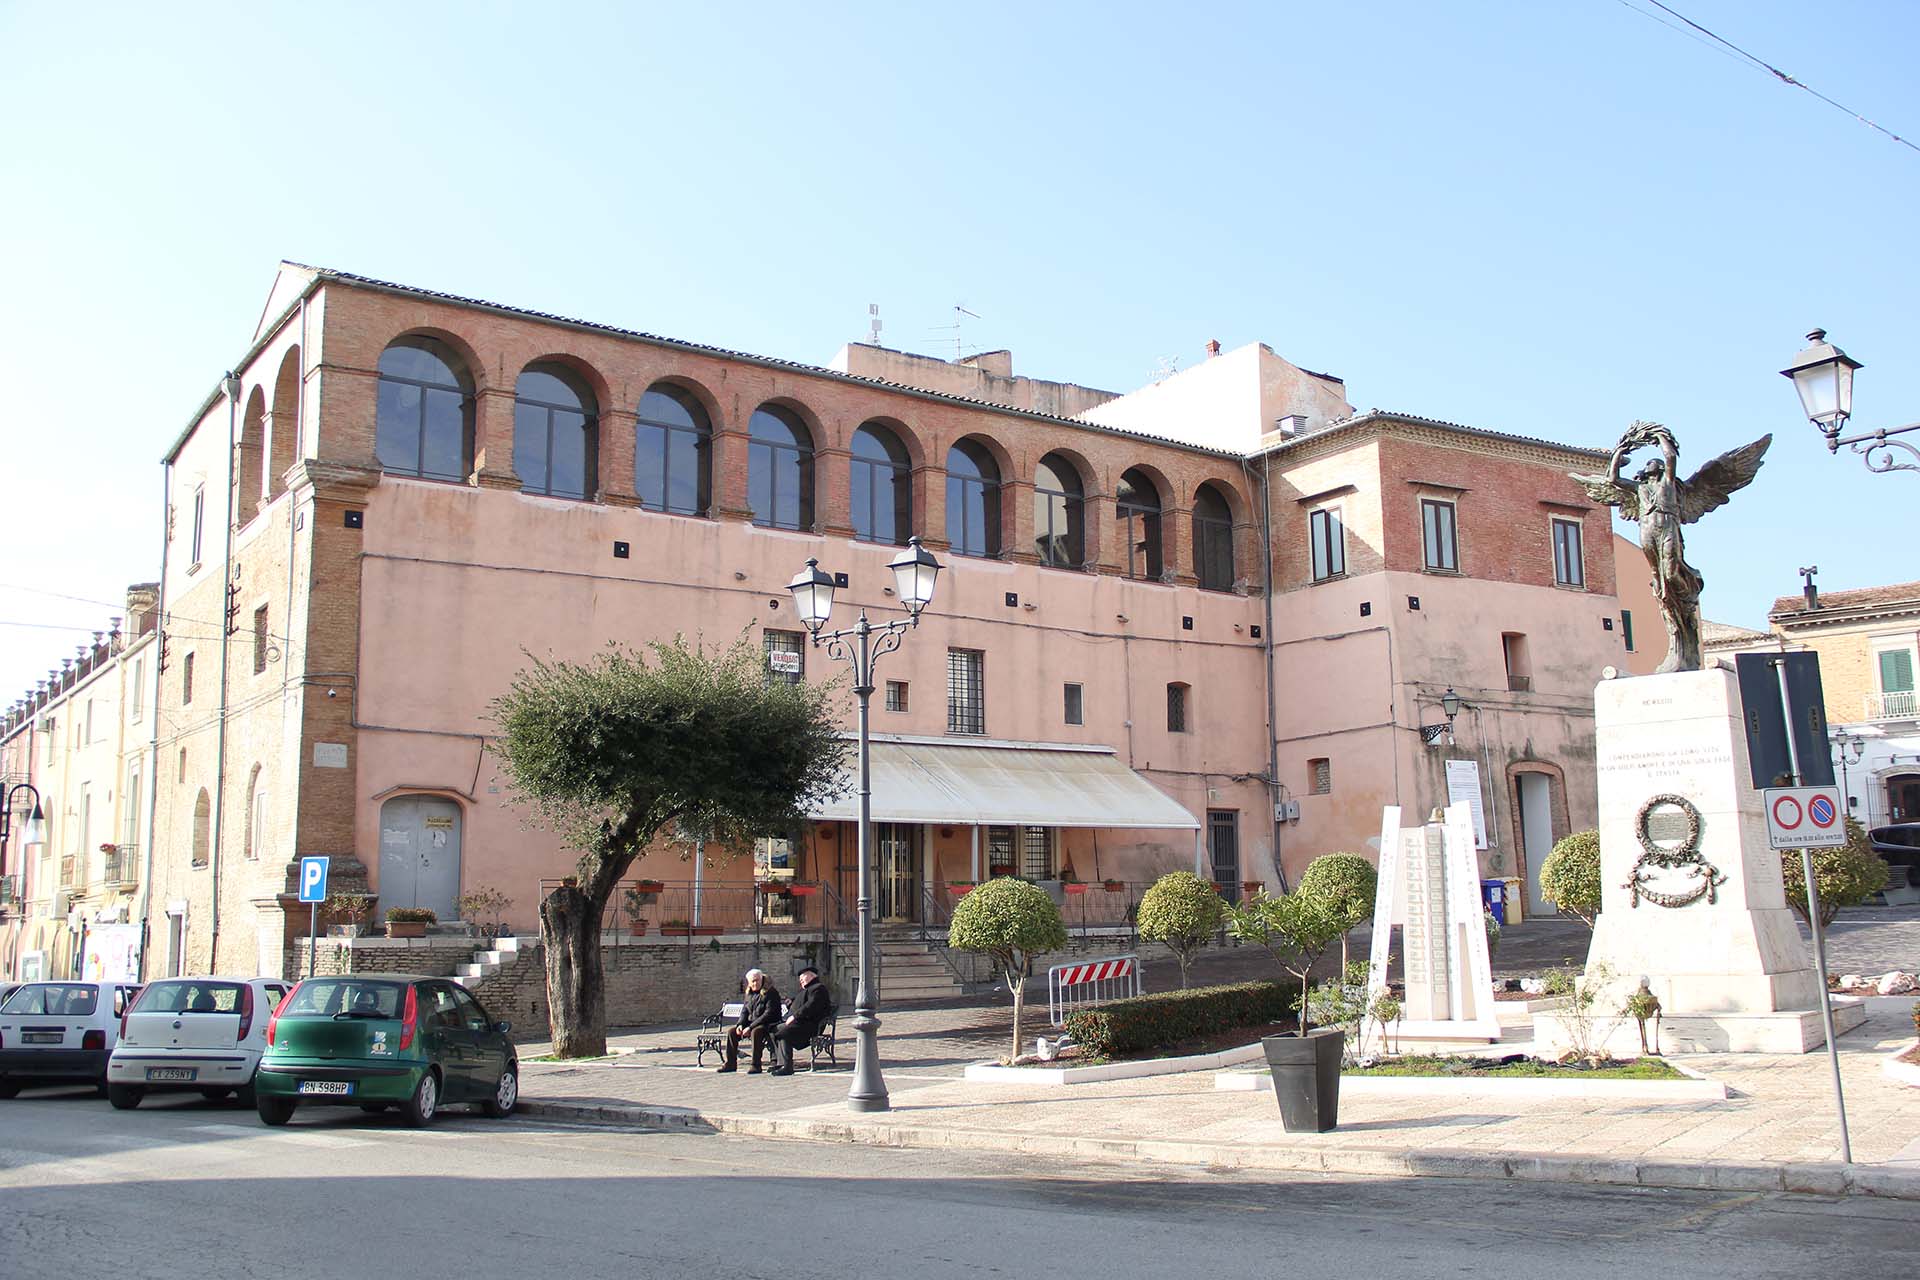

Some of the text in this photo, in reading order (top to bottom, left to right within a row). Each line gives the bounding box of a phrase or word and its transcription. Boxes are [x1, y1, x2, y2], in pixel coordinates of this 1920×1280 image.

[304, 861, 322, 897] P
[304, 1082, 347, 1093] BN 398HP
